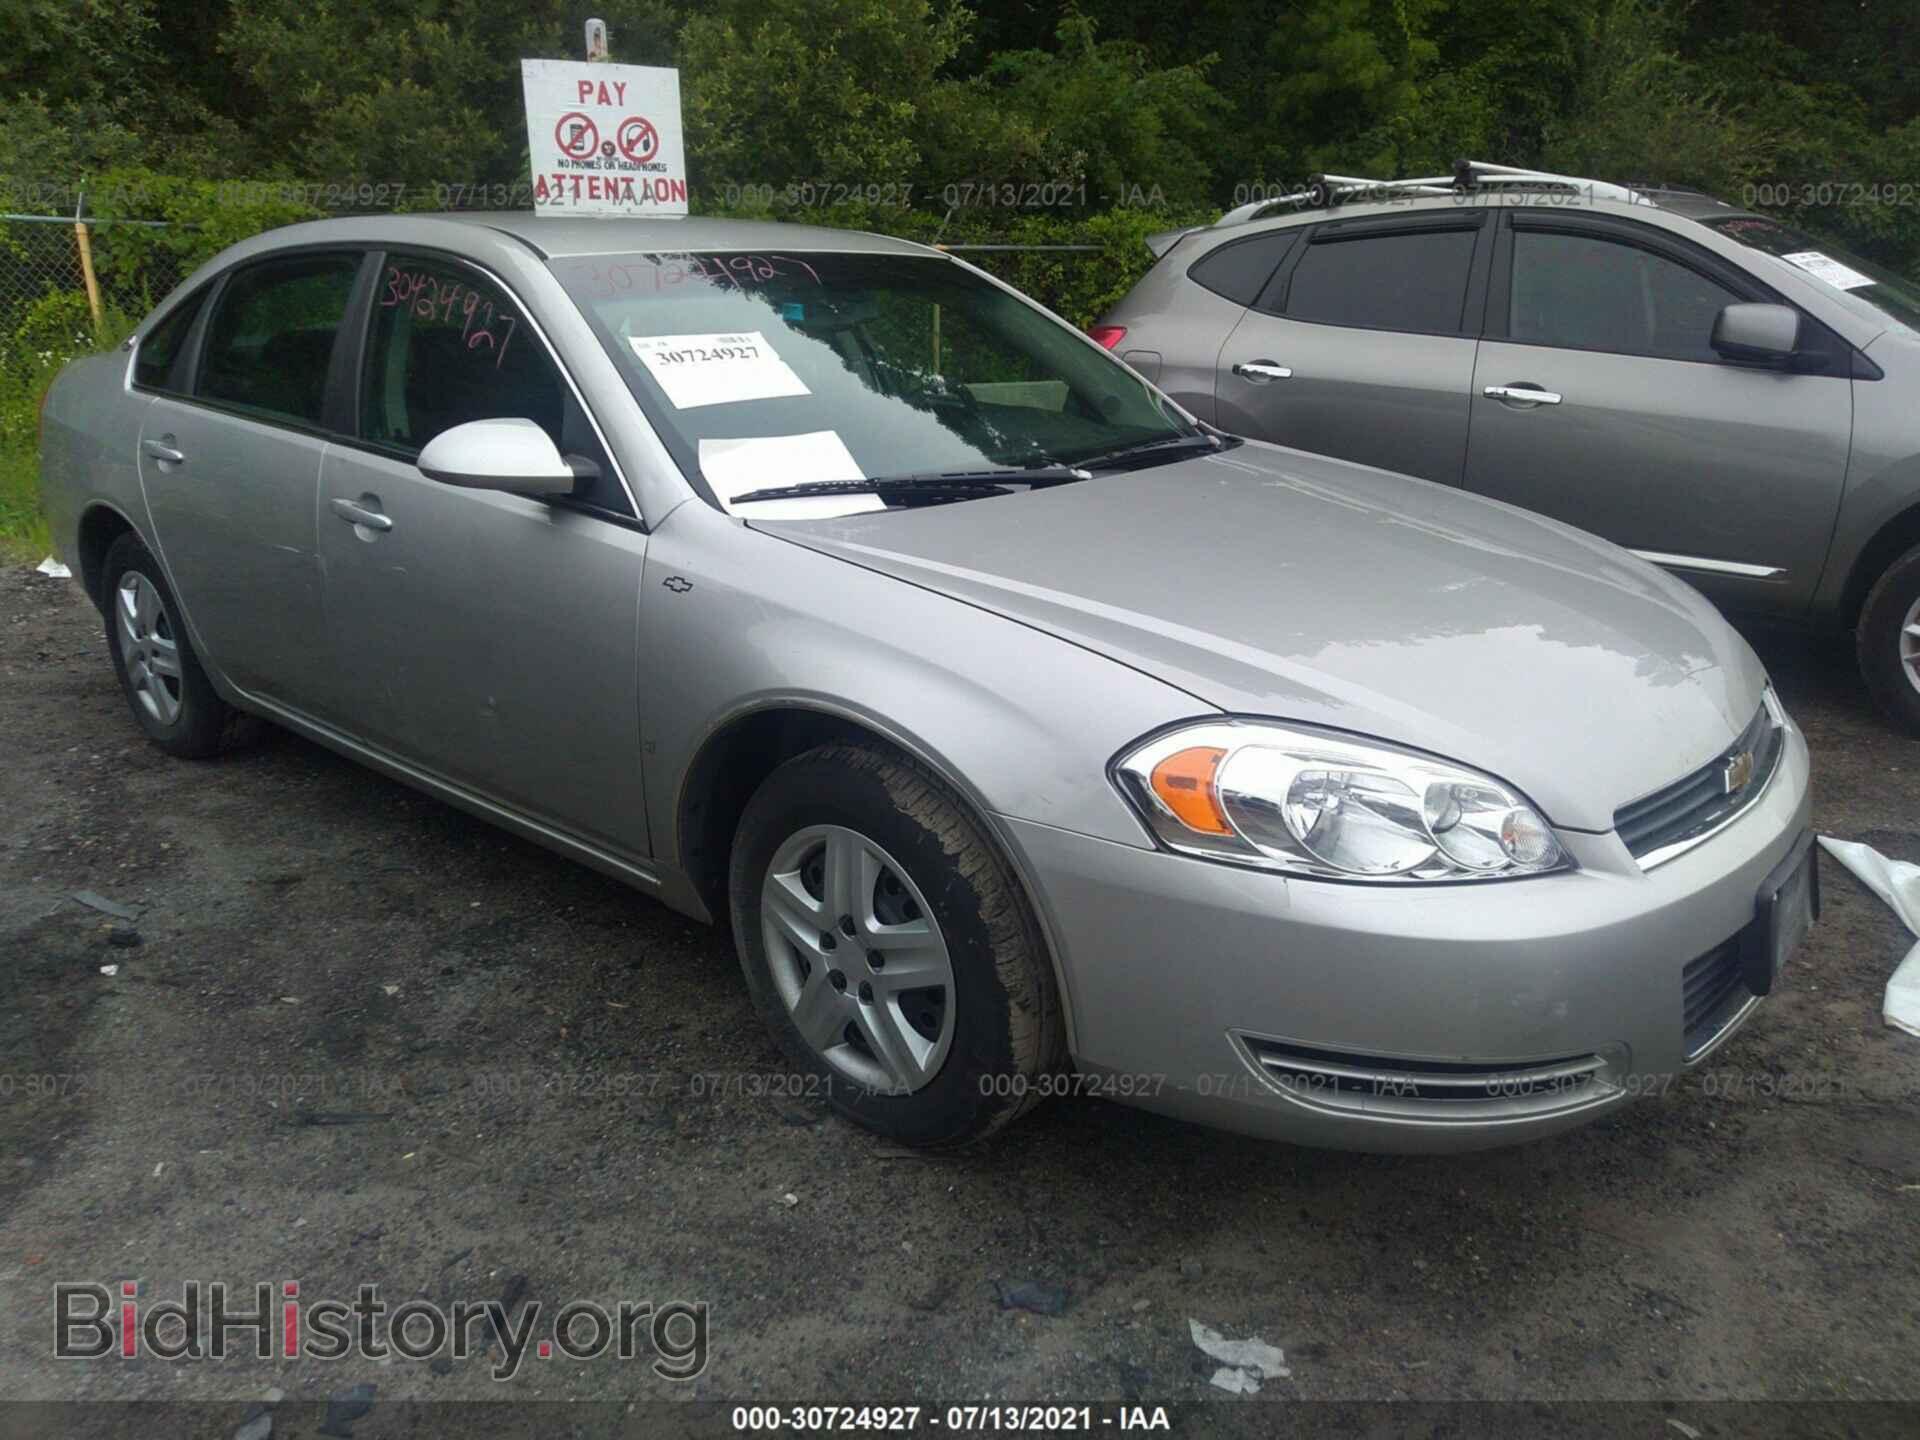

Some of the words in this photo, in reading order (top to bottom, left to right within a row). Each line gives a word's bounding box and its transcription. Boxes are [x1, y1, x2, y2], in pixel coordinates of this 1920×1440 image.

[577, 80, 627, 106] PAY
[557, 159, 570, 168] NO
[534, 174, 687, 202] ATTENTION
[655, 346, 760, 366] 30724927
